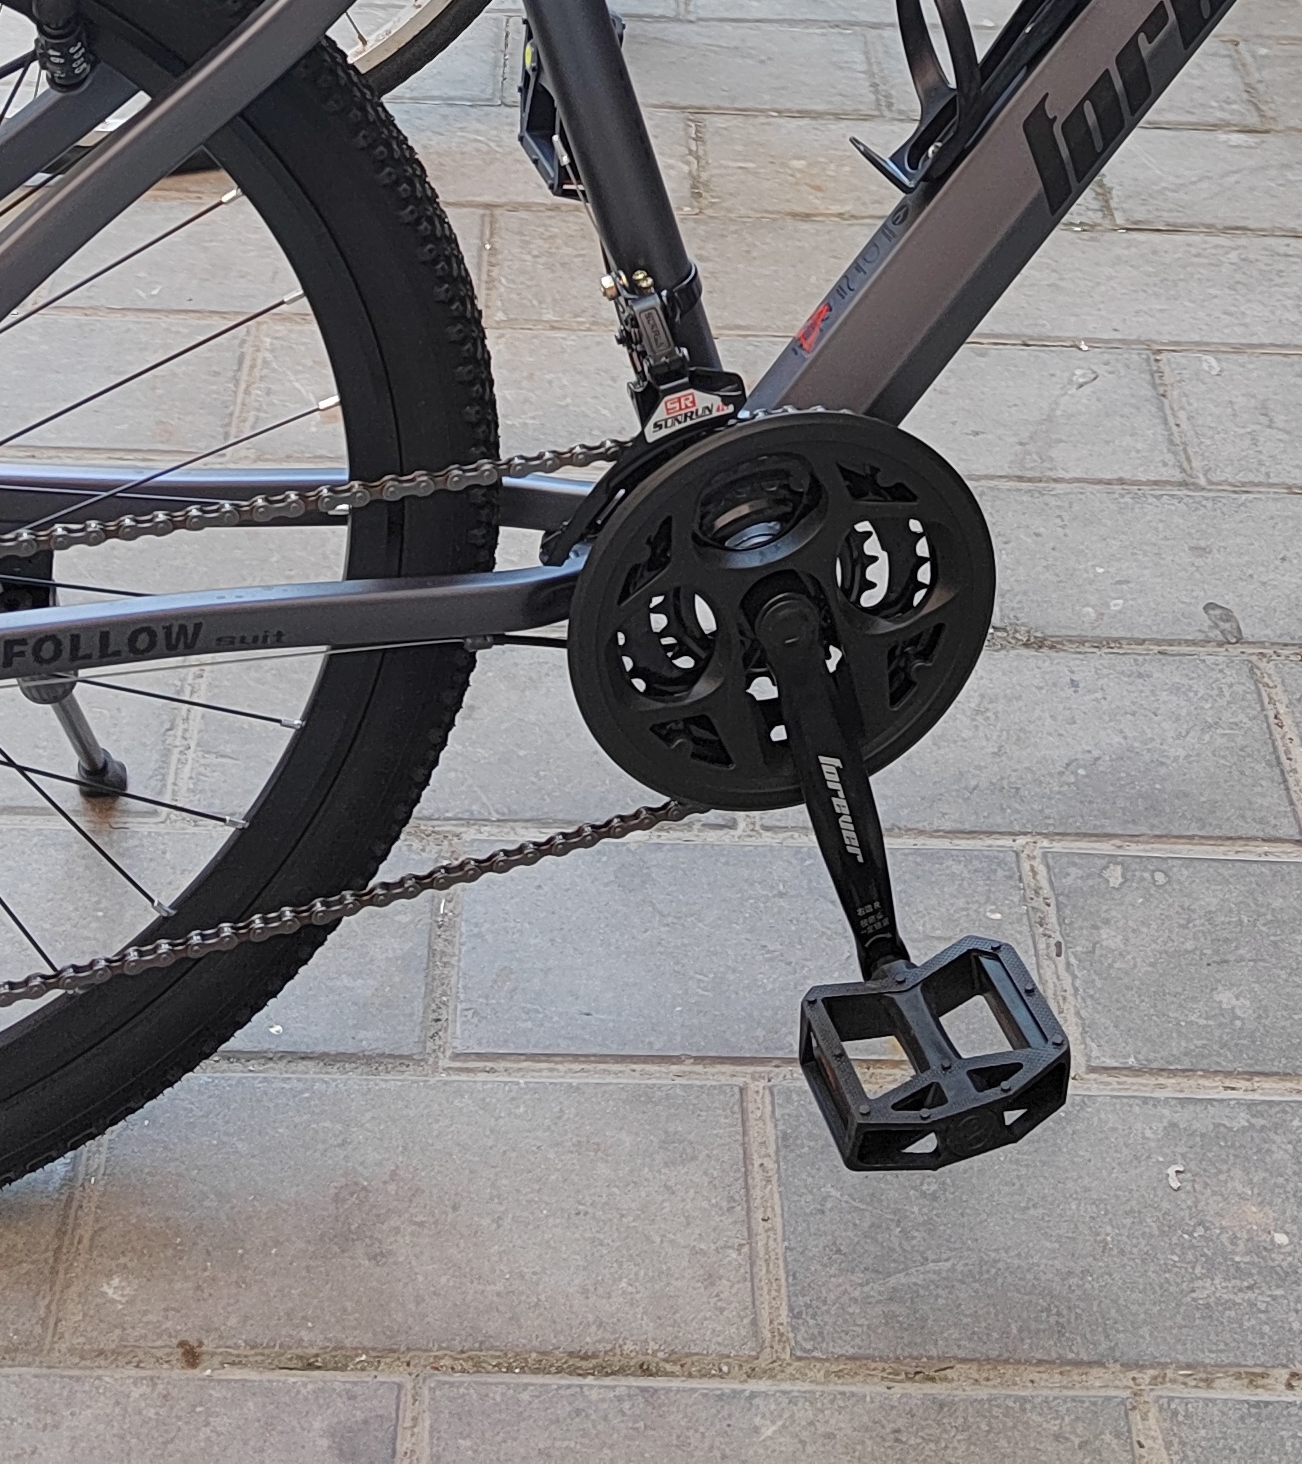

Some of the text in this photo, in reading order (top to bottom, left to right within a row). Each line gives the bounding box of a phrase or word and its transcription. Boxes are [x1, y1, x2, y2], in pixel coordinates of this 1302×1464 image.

[652, 402, 714, 433] SUNRUN
[666, 393, 695, 414] SR
[2, 621, 203, 668] FOLLOW
[818, 755, 864, 863] forever
